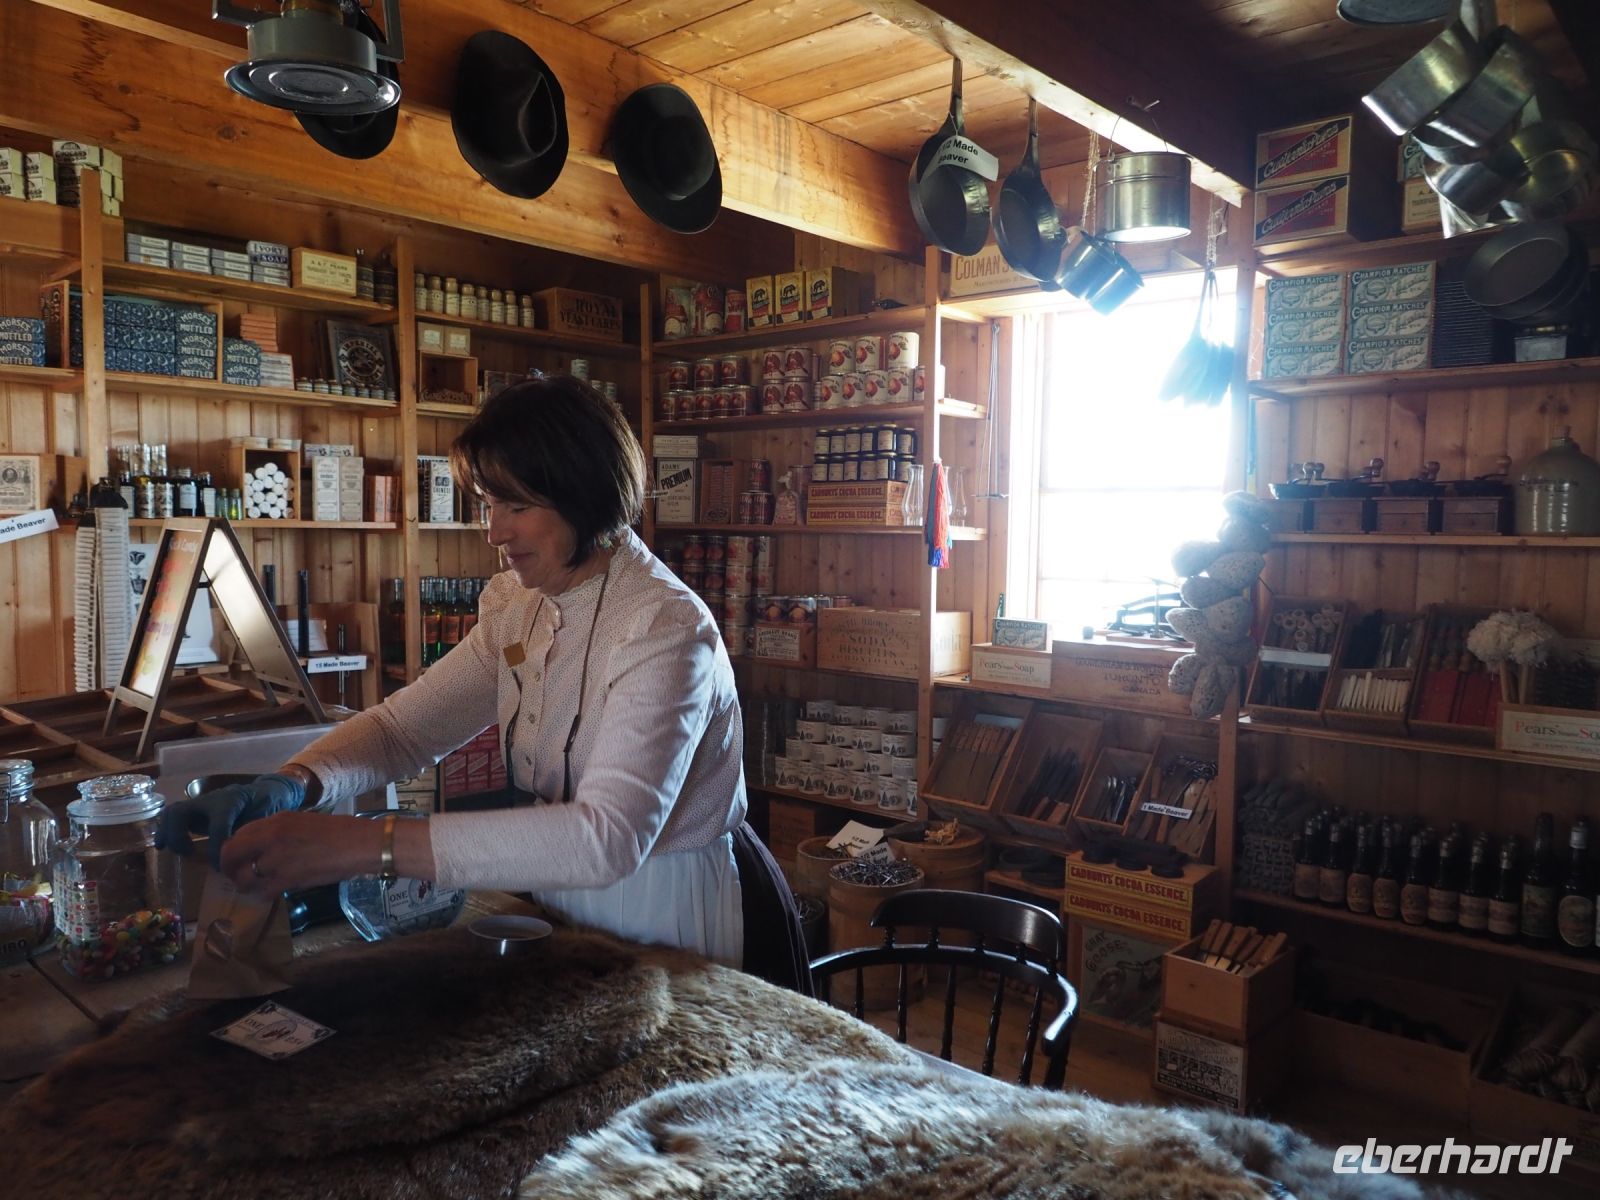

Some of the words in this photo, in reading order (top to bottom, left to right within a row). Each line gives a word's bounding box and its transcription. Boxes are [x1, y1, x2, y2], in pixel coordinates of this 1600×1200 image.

[953, 138, 979, 156] Made
[254, 244, 284, 254] IVORY
[260, 255, 286, 264] SOAP
[1352, 269, 1392, 285] CHAMPION
[1393, 265, 1426, 274] MATCHES
[1269, 278, 1304, 292] CHAMPION
[1305, 275, 1338, 284] MATCHES
[1269, 311, 1304, 326] CHAMPION
[1305, 309, 1338, 318] MATCHES
[1351, 304, 1392, 320] CHAMPION
[1393, 301, 1426, 311] MATCHES
[180, 324, 213, 335] MOTTLED
[181, 346, 214, 357] MOTTLED
[1267, 345, 1304, 360] CHAMPION
[1304, 343, 1337, 353] MATCHES
[1349, 339, 1390, 354] CHAMPION
[1390, 338, 1422, 347] MATCHES
[226, 354, 258, 365] MOTTLED
[180, 368, 214, 379] MOTTLED
[226, 376, 258, 387] MOTTLED
[660, 468, 692, 490] PREMIUM
[0, 526, 16, 535] ade
[16, 517, 46, 530] Beaver
[1014, 662, 1035, 675] Soap
[1104, 673, 1161, 686] TORONTO
[1579, 727, 1600, 740] So
[1148, 804, 1165, 813] Made
[1165, 808, 1190, 817] Beaver
[1114, 875, 1143, 893] COCOA
[1113, 904, 1141, 921] COCOA
